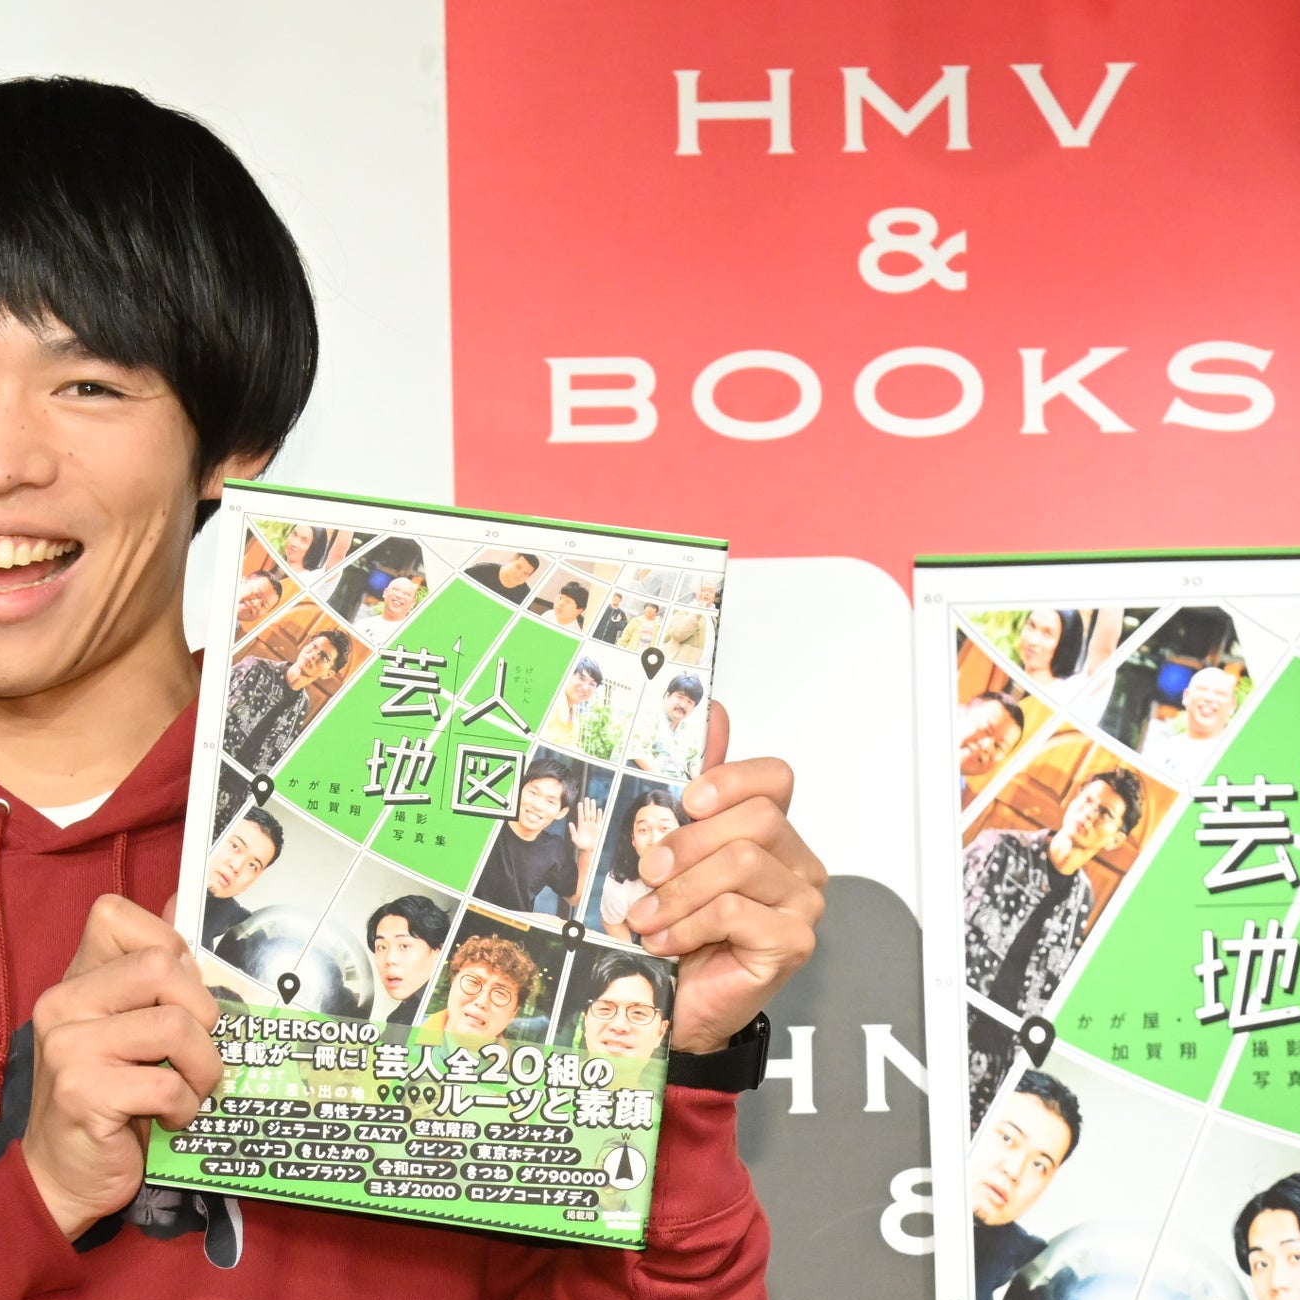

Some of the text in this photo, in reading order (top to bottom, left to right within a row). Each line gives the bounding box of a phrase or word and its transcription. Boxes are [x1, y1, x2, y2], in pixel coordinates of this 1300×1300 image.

[673, 61, 1138, 156] HMV
[857, 207, 968, 294] &
[544, 340, 1277, 444] BOOKS
[379, 644, 531, 734] 芸人
[363, 736, 526, 822] 地図
[306, 799, 362, 817] 加賀翔
[394, 811, 428, 824] 撮影
[392, 828, 446, 847] 写真集
[214, 1040, 368, 1071] 連載が一冊に!
[1111, 1042, 1197, 1061] 加賀翔
[373, 1043, 615, 1089] 芸人全20組の
[223, 1099, 308, 1117] モグライダー
[319, 1103, 406, 1121] 男性ブランコ
[436, 1084, 655, 1128] ルーツと素顔
[267, 1122, 347, 1139] ジェラードン
[358, 1127, 403, 1142] ZAZY
[415, 1121, 478, 1139] 空気階段
[489, 1125, 569, 1144] ランジャタイ
[174, 1138, 232, 1154] カゲヤマ
[244, 1143, 287, 1157] ハナコ
[301, 1144, 370, 1161] きしたかの
[477, 1145, 578, 1165] 東京ホテイソン
[205, 1160, 260, 1176] マユリカ
[378, 1159, 453, 1178] 令和ロマン
[466, 1164, 509, 1180] きつね
[520, 1166, 607, 1186] ダウ90000
[370, 1180, 594, 1207] ヨネダ2000 ロングコートダディ
